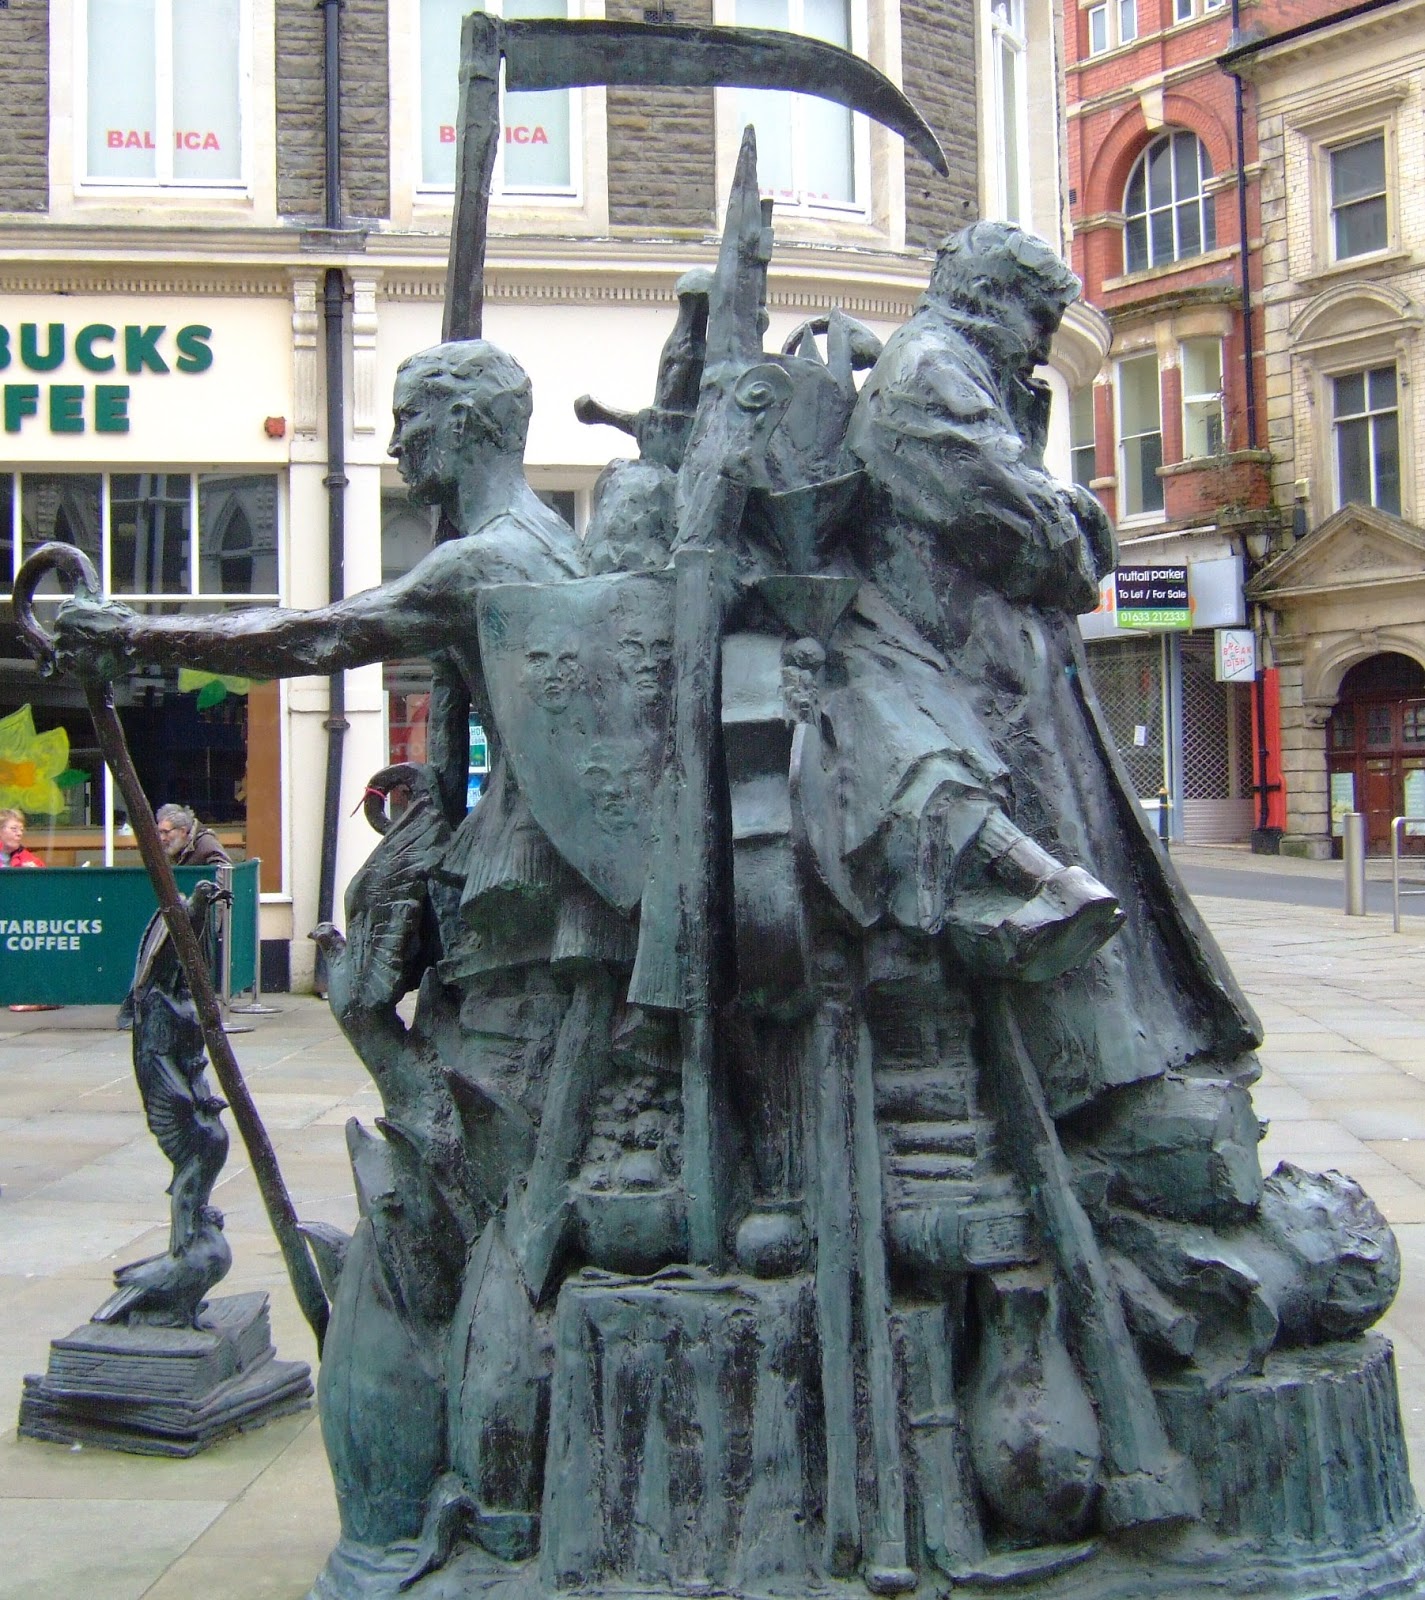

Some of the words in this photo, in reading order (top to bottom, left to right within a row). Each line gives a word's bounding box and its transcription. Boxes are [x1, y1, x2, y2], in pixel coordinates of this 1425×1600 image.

[107, 130, 220, 150] BALICA
[439, 126, 549, 144] BICA
[4, 384, 130, 432] FEE
[1118, 570, 1150, 582] nuttall
[1151, 569, 1185, 581] parker
[1118, 589, 1129, 599] To
[1130, 589, 1144, 599] Let
[1152, 589, 1167, 599] For
[1167, 589, 1187, 599] Sale
[1120, 612, 1150, 622] 01633
[1151, 612, 1187, 622] 212333
[6, 936, 80, 951] COFFEE
